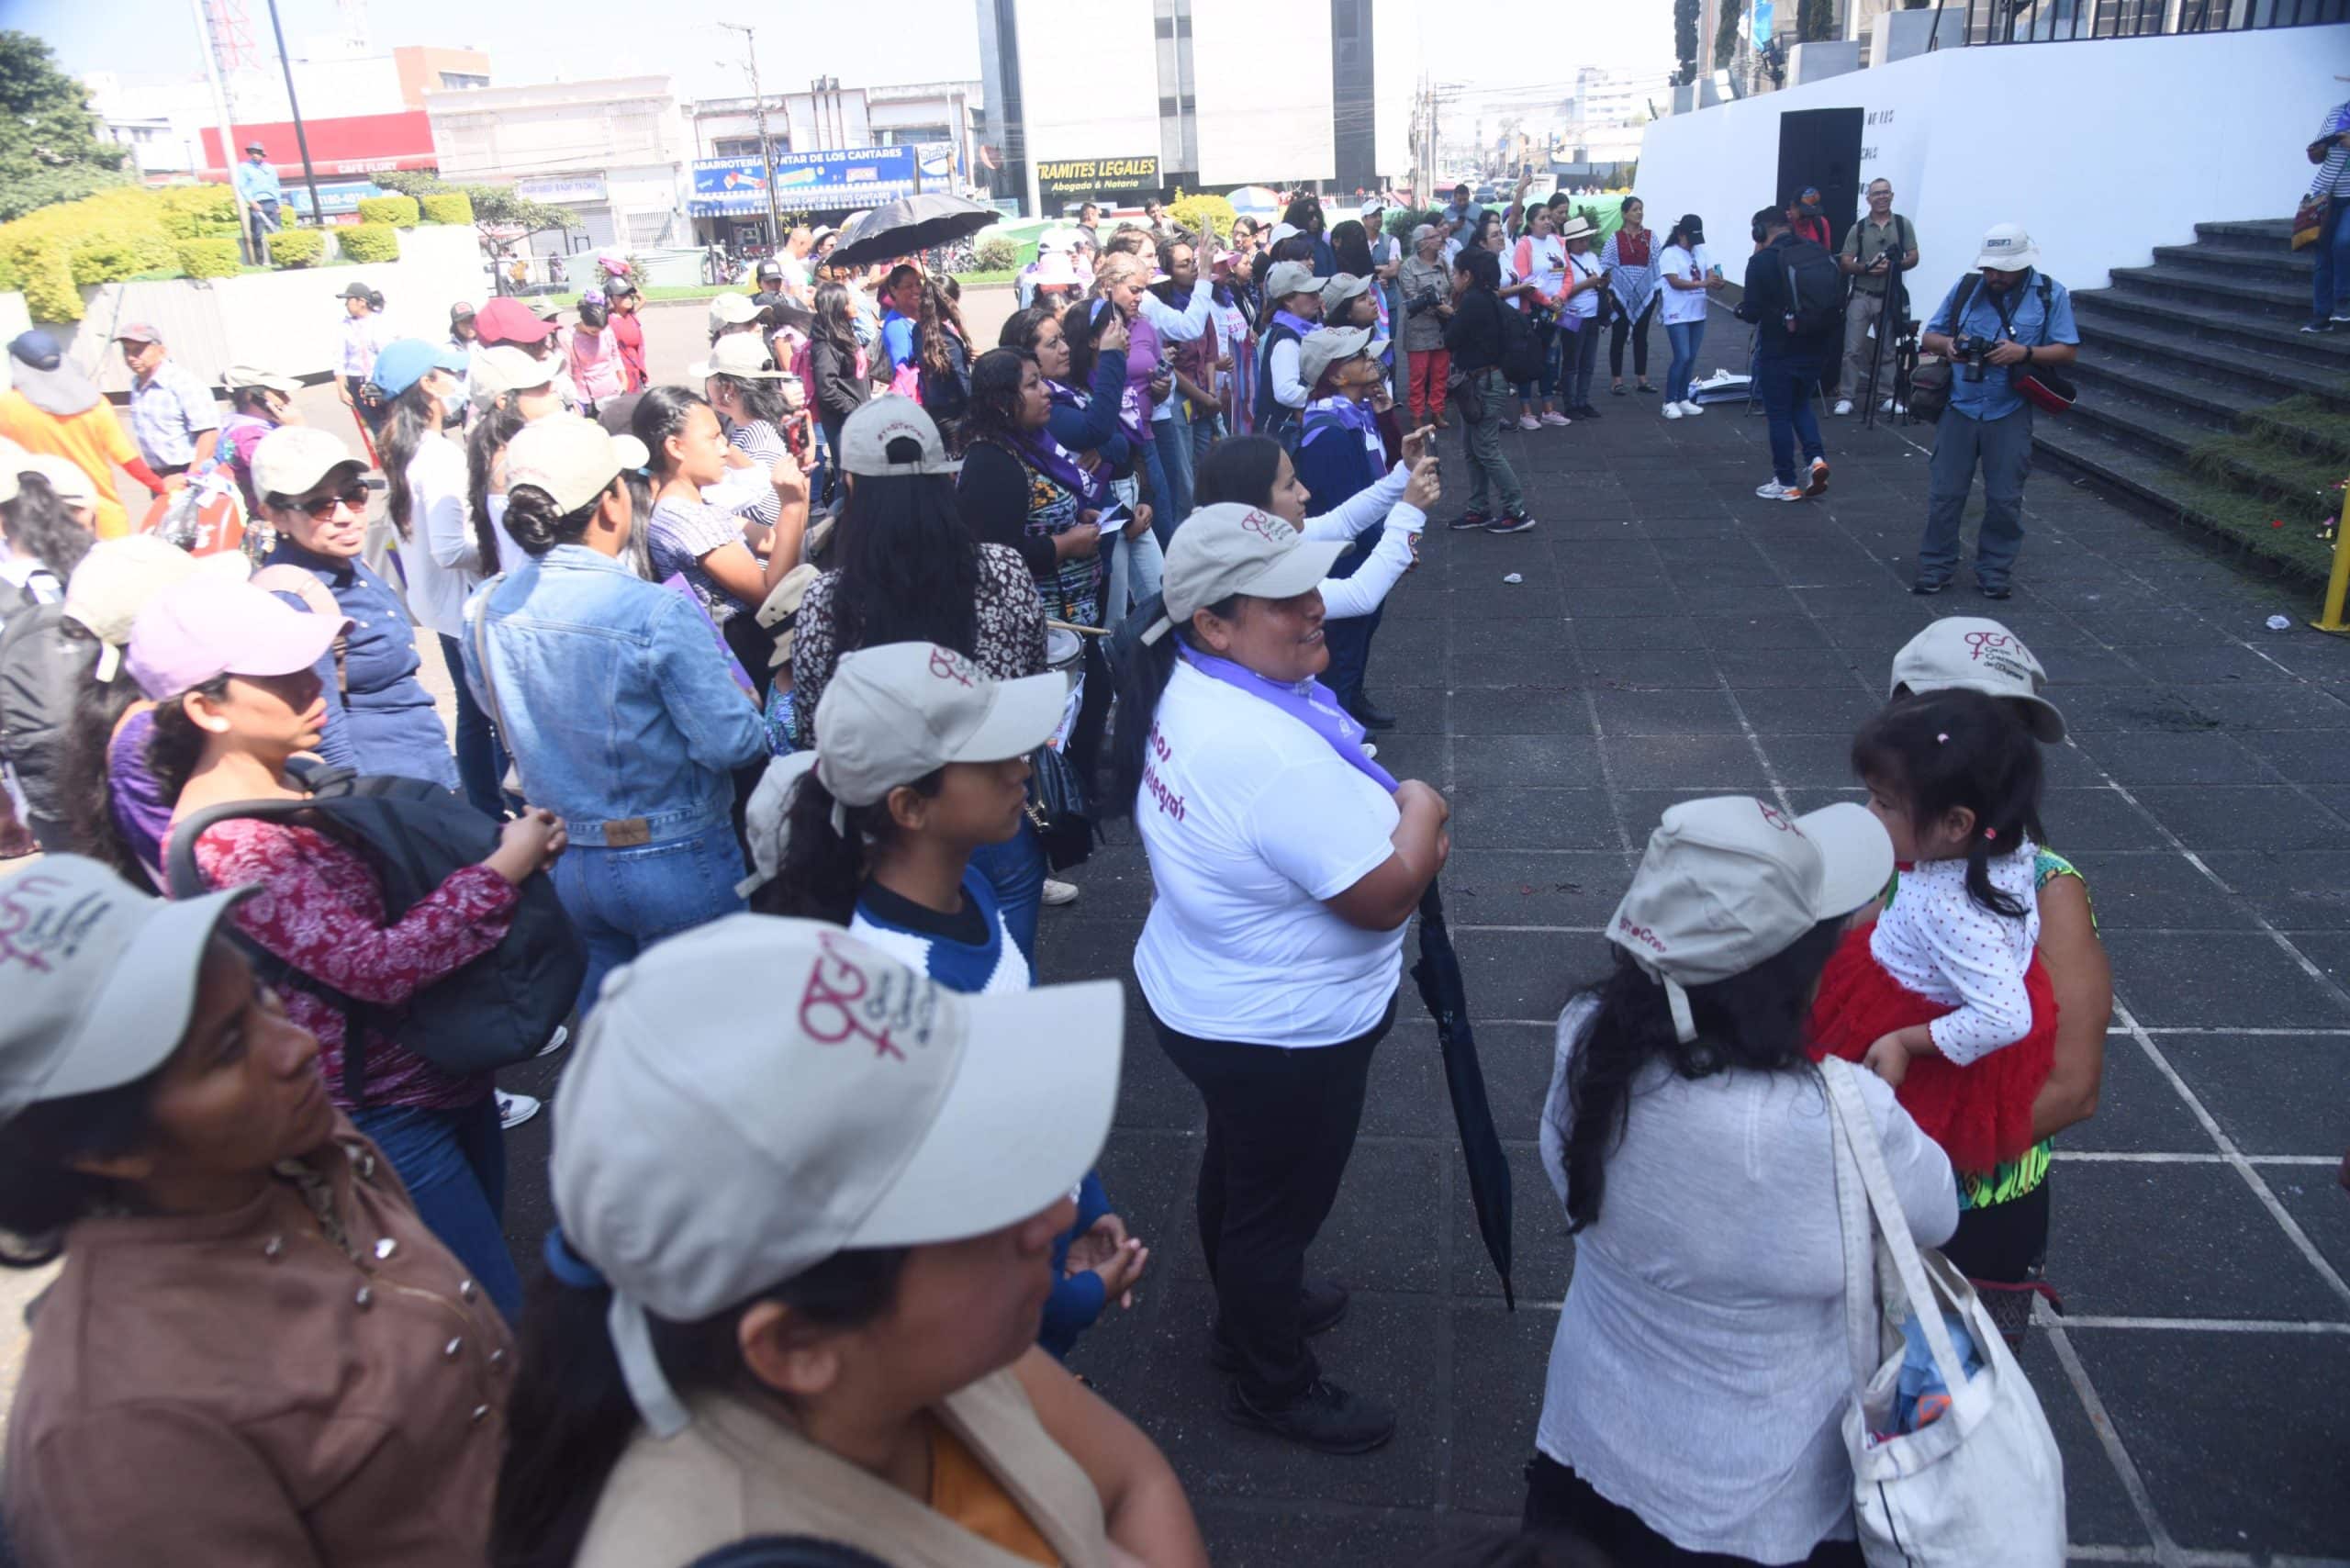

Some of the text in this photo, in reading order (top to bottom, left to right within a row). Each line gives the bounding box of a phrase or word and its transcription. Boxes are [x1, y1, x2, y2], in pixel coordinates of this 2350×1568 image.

[809, 153, 824, 163] DE
[825, 151, 846, 162] LOS
[847, 148, 902, 162] CANTARES
[1036, 159, 1156, 180] TRAMITES LEGALES
[1051, 180, 1092, 192] Abogado
[1104, 178, 1139, 189] Notario
